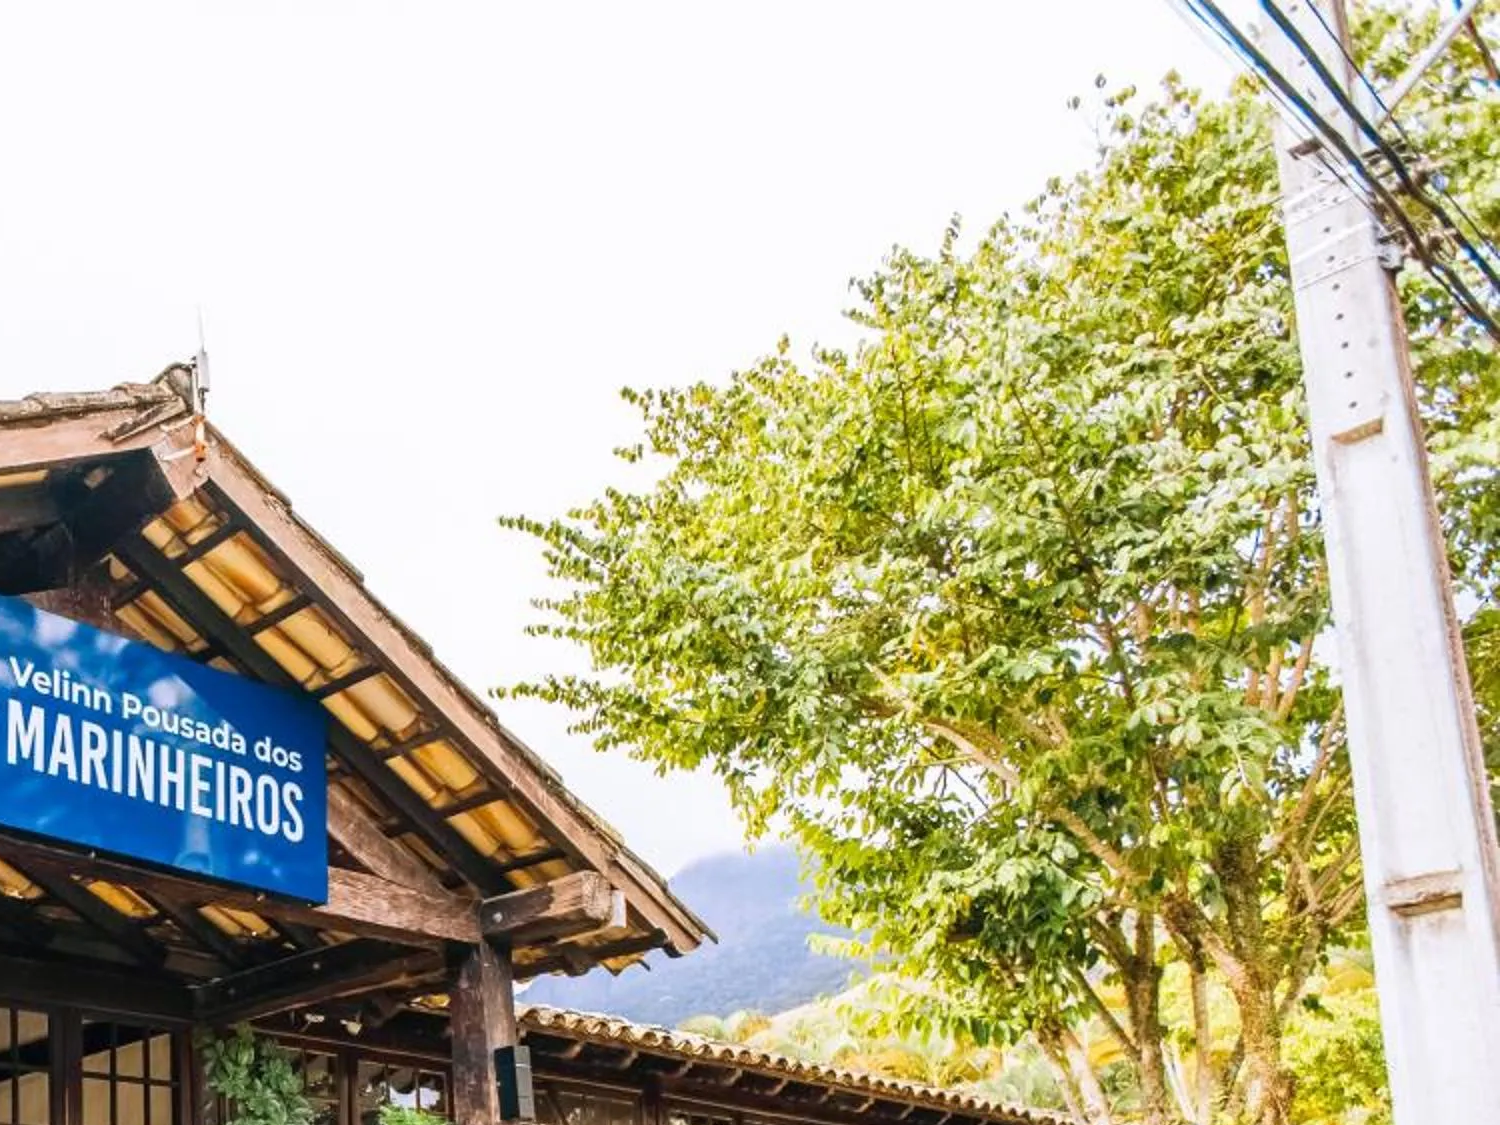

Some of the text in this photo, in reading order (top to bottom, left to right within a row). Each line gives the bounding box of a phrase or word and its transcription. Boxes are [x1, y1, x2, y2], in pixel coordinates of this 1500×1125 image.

[7, 699, 305, 843] MARINHEIROS
[9, 656, 304, 773] Velinn Pousada dos
